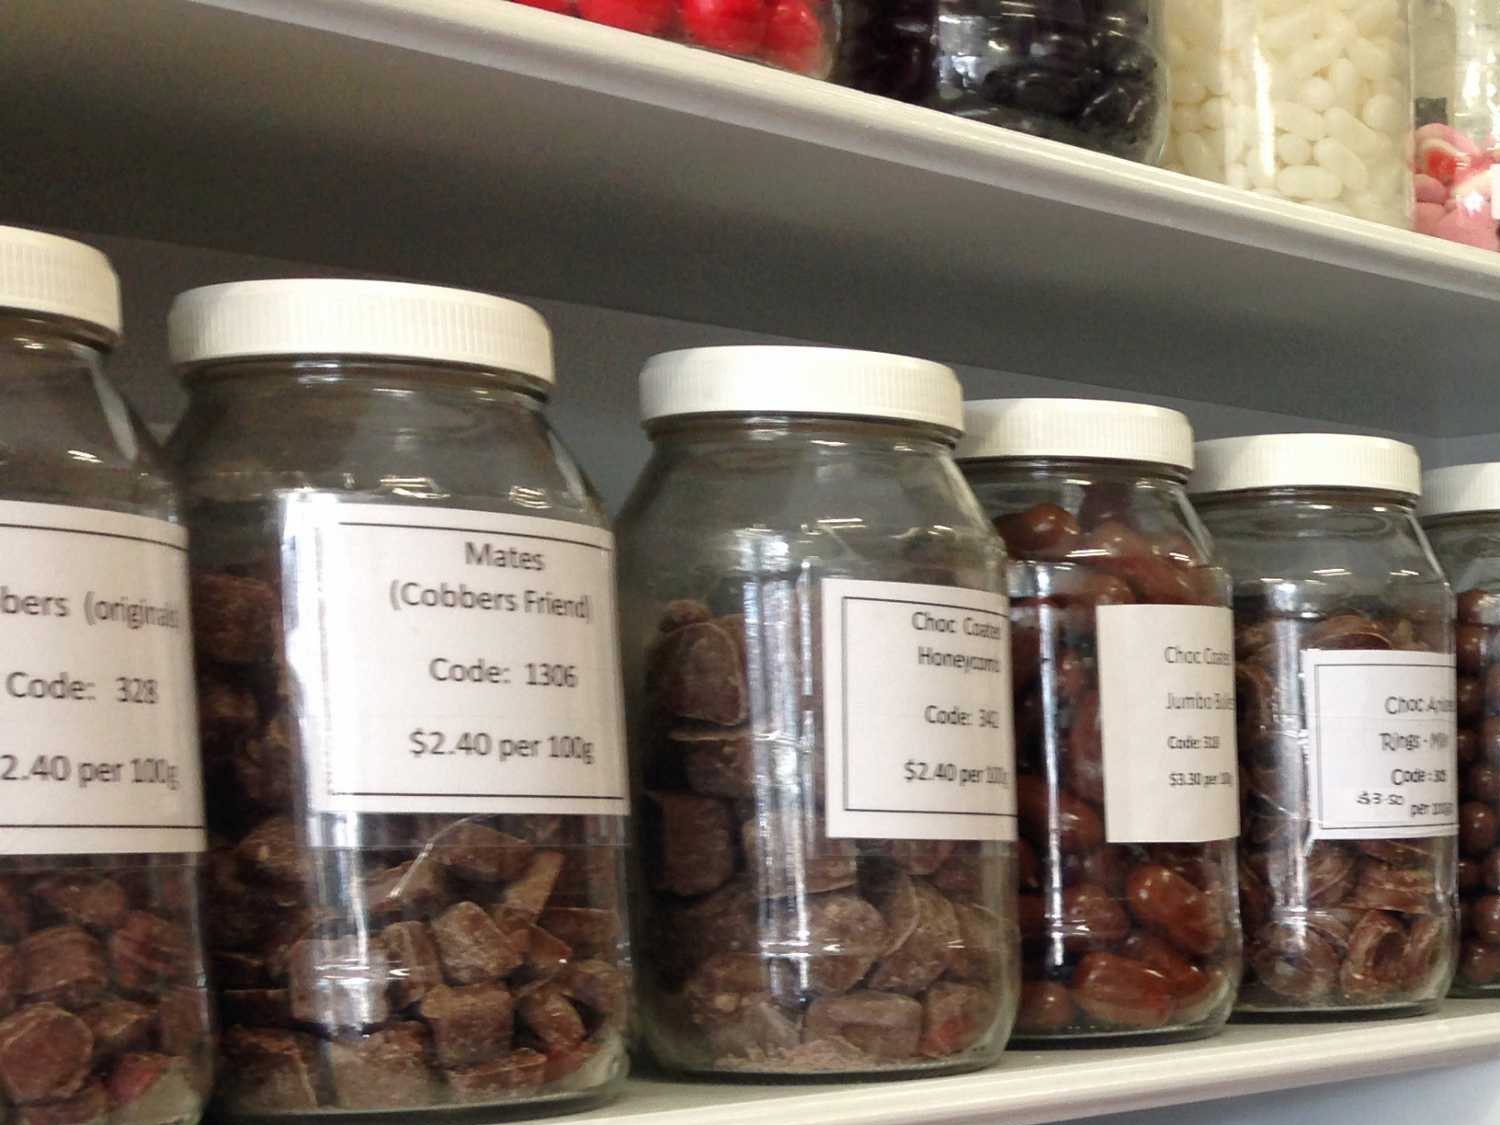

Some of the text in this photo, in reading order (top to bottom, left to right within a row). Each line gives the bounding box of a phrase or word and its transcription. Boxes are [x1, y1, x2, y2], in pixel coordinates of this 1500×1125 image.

[464, 541, 545, 571] Mates
[389, 578, 591, 624] (Cobbers Friend)
[911, 611, 957, 634] Choc
[1165, 645, 1201, 665] Choc
[428, 657, 578, 688] Code: 1306
[6, 671, 159, 705] Code: 328
[924, 704, 973, 727] Code:
[1384, 696, 1423, 715] Choc
[408, 727, 595, 765] $2.40 per 100g
[78, 761, 123, 788] per
[130, 758, 180, 791] 100g
[903, 759, 957, 784] $2.40
[960, 767, 984, 787] per
[1169, 771, 1201, 787] $3.30
